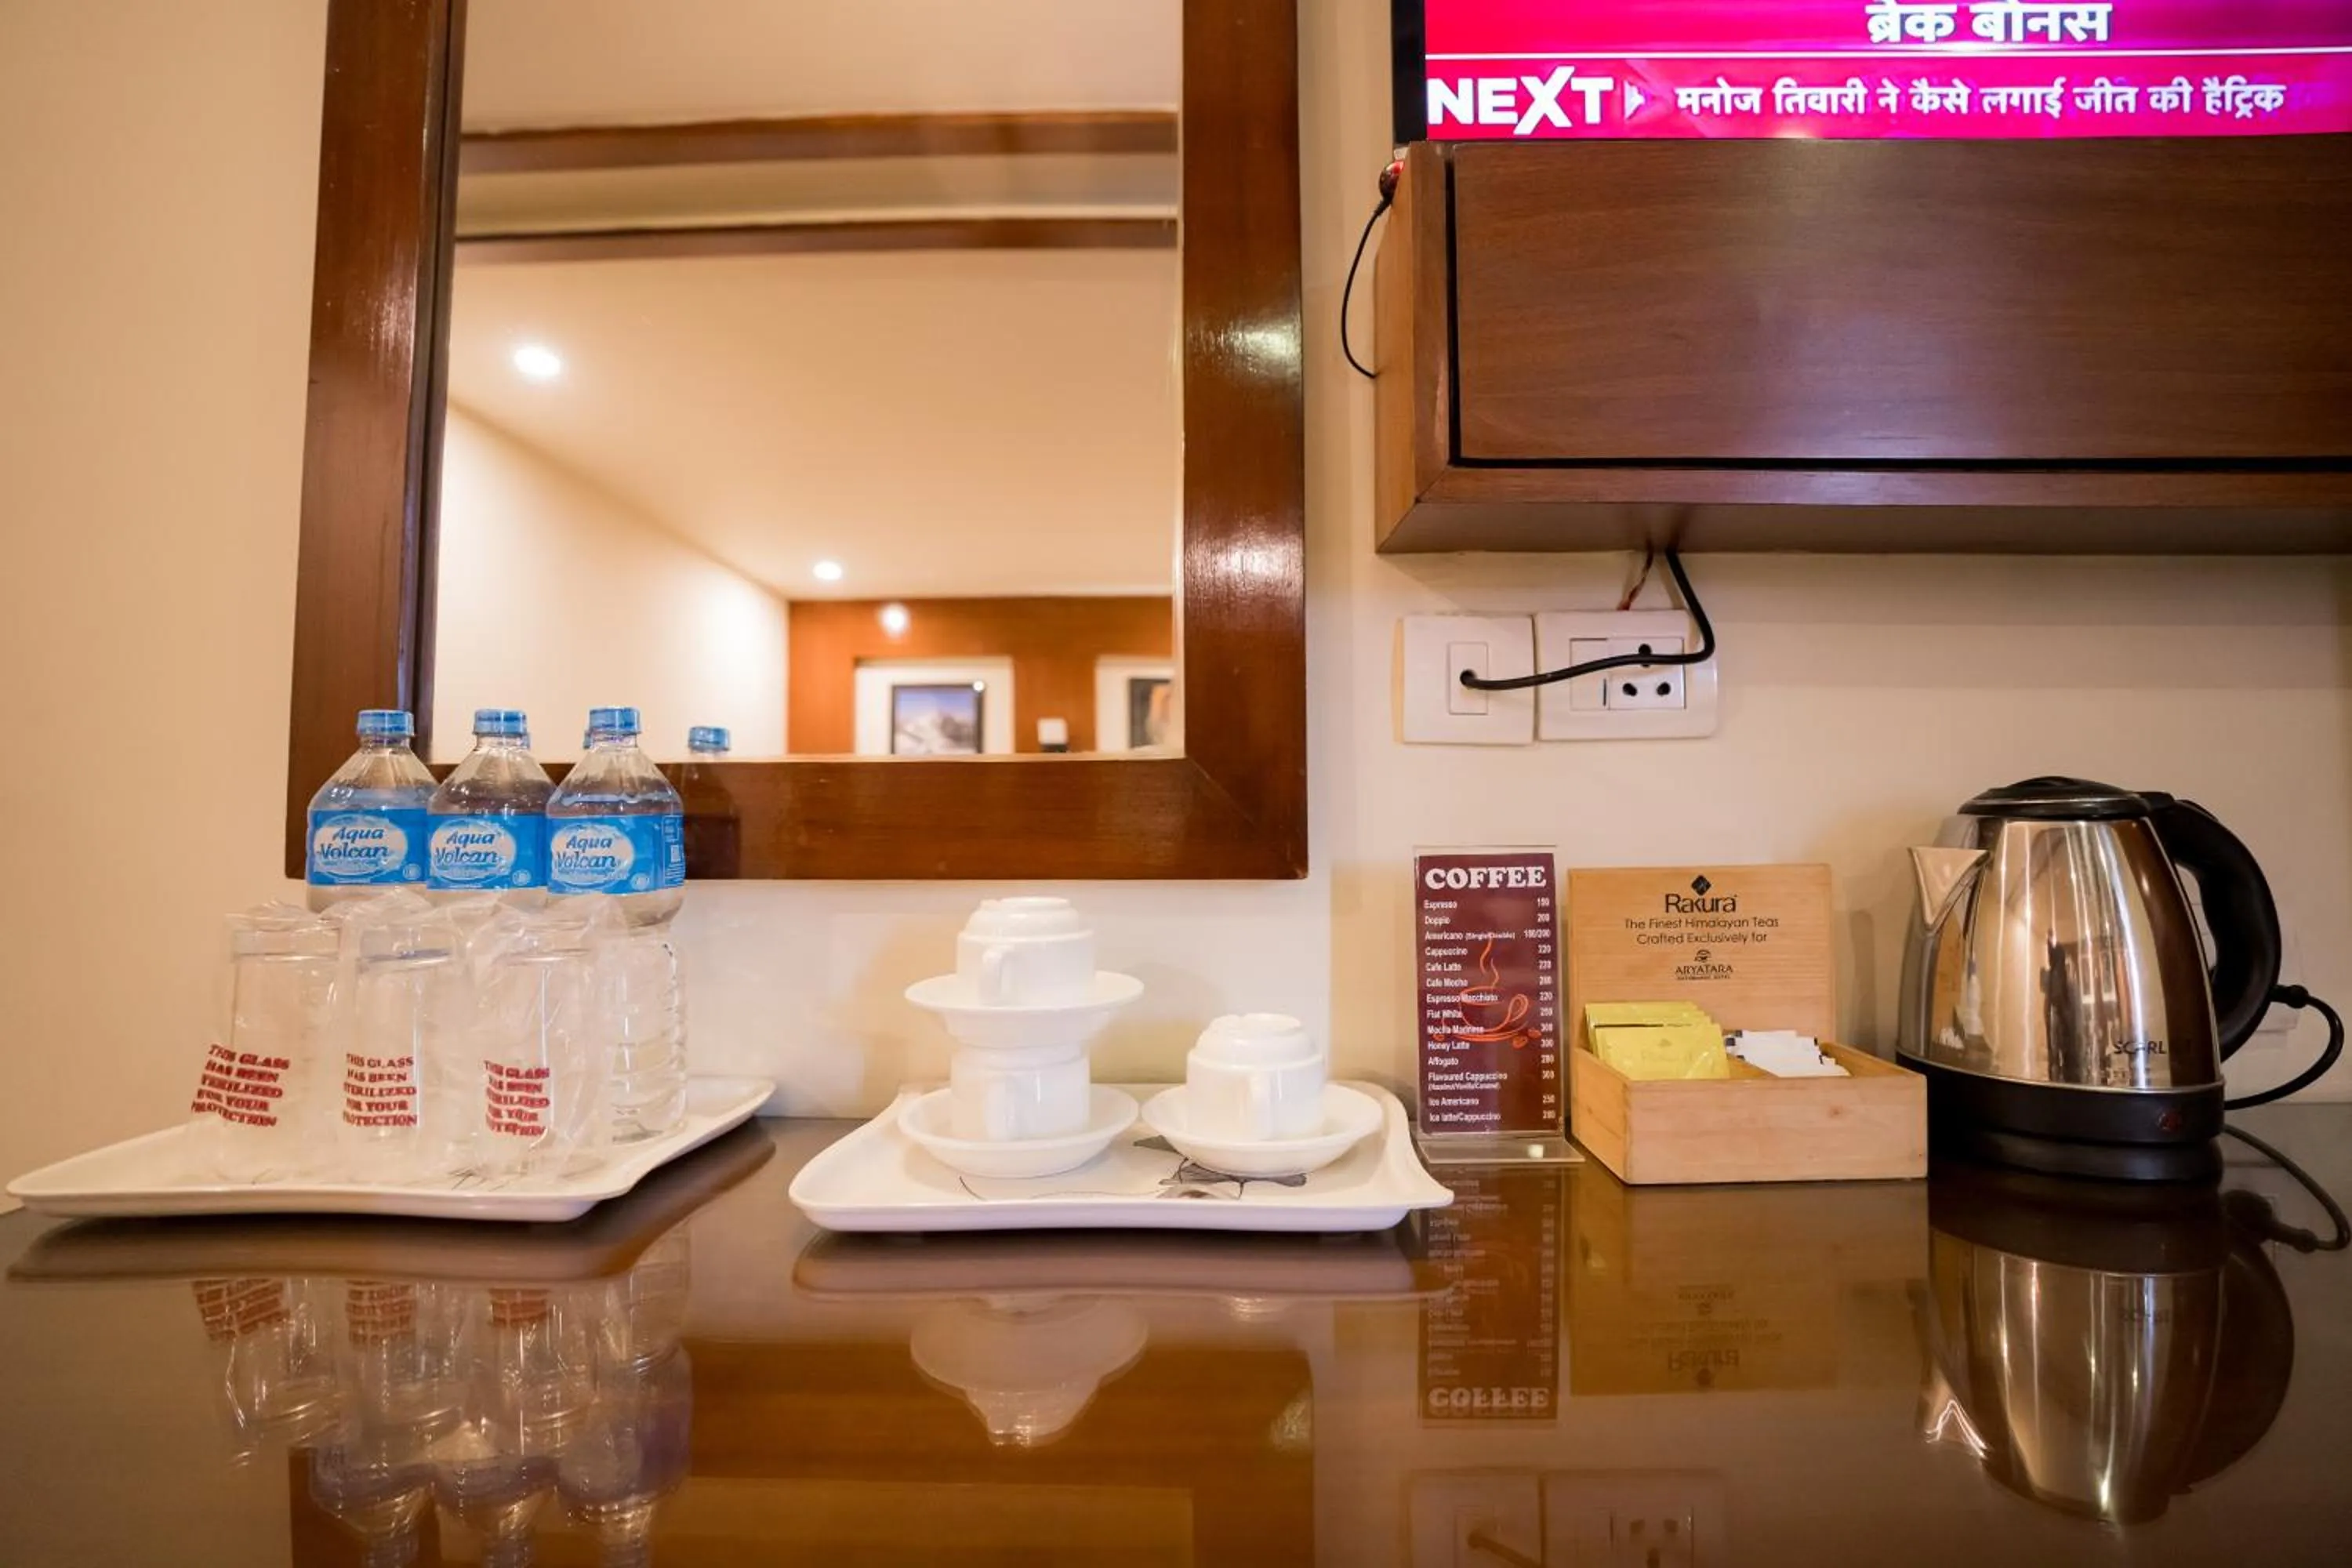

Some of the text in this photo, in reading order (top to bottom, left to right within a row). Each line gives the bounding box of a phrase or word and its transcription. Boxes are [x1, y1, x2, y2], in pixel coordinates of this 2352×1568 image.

[1427, 66, 1614, 135] NEXT
[1675, 75, 2286, 118] मनोज तिवारी ने कैसे लगाई जीत की हैट्रिक
[332, 826, 385, 844] Aqua
[445, 831, 496, 848] Aqua
[565, 834, 613, 853] Aqua
[318, 842, 389, 859] Volcan
[434, 847, 499, 863] Volcan
[557, 851, 617, 869] Volcan
[1425, 866, 1547, 889] COFFEE
[1664, 893, 1737, 913] Rakura
[1425, 916, 1451, 927] Doppio
[1624, 916, 1780, 931] The Finest Himalayan Teas
[1425, 931, 1464, 940] Americano
[1636, 933, 1767, 945] Crafted Exclusively for
[1425, 946, 1468, 956] Cappuccino
[1425, 963, 1443, 971] Cafe
[1443, 963, 1461, 971] Latte
[1675, 964, 1733, 975] ARYATARA
[1426, 978, 1443, 987] Cafe
[1426, 993, 1461, 1004] Espresso
[1427, 1009, 1441, 1018] Flat
[1442, 1009, 1463, 1018] White
[1428, 1041, 1450, 1051] Honey
[1451, 1041, 1470, 1050] Latte
[209, 1044, 290, 1069] THIS GLASS
[366, 1056, 414, 1069] GLASS
[1428, 1056, 1459, 1067] Affogato
[205, 1059, 280, 1083] HAS BEEN
[347, 1069, 407, 1083] HAS BEEN
[505, 1067, 550, 1080] GLASS
[1428, 1072, 1464, 1081] Flavoured
[1465, 1071, 1508, 1082] Cappuccino
[506, 1082, 543, 1093] BEEN
[226, 1095, 270, 1112] YOUR
[365, 1100, 408, 1112] YOUR
[1441, 1097, 1479, 1105] Americano
[506, 1109, 538, 1123] YOUR
[1429, 1113, 1440, 1122] Ice
